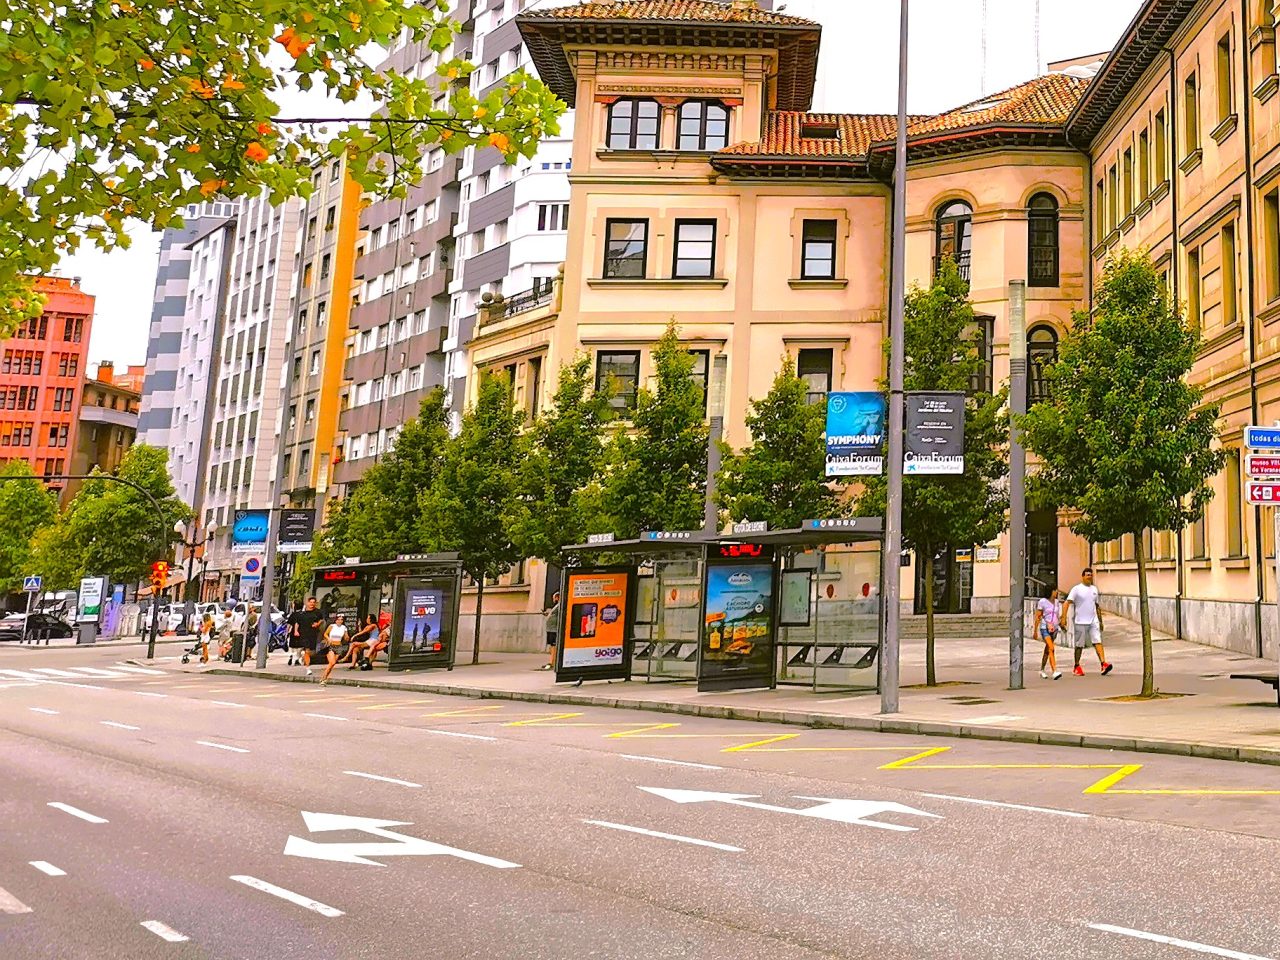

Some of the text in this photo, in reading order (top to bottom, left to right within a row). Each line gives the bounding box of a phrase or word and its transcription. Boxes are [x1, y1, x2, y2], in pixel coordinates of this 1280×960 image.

[828, 434, 881, 446] SYMPHONY
[826, 452, 882, 463] CaixaForum
[904, 452, 964, 462] CaixaForum
[594, 648, 622, 658] yoigo
